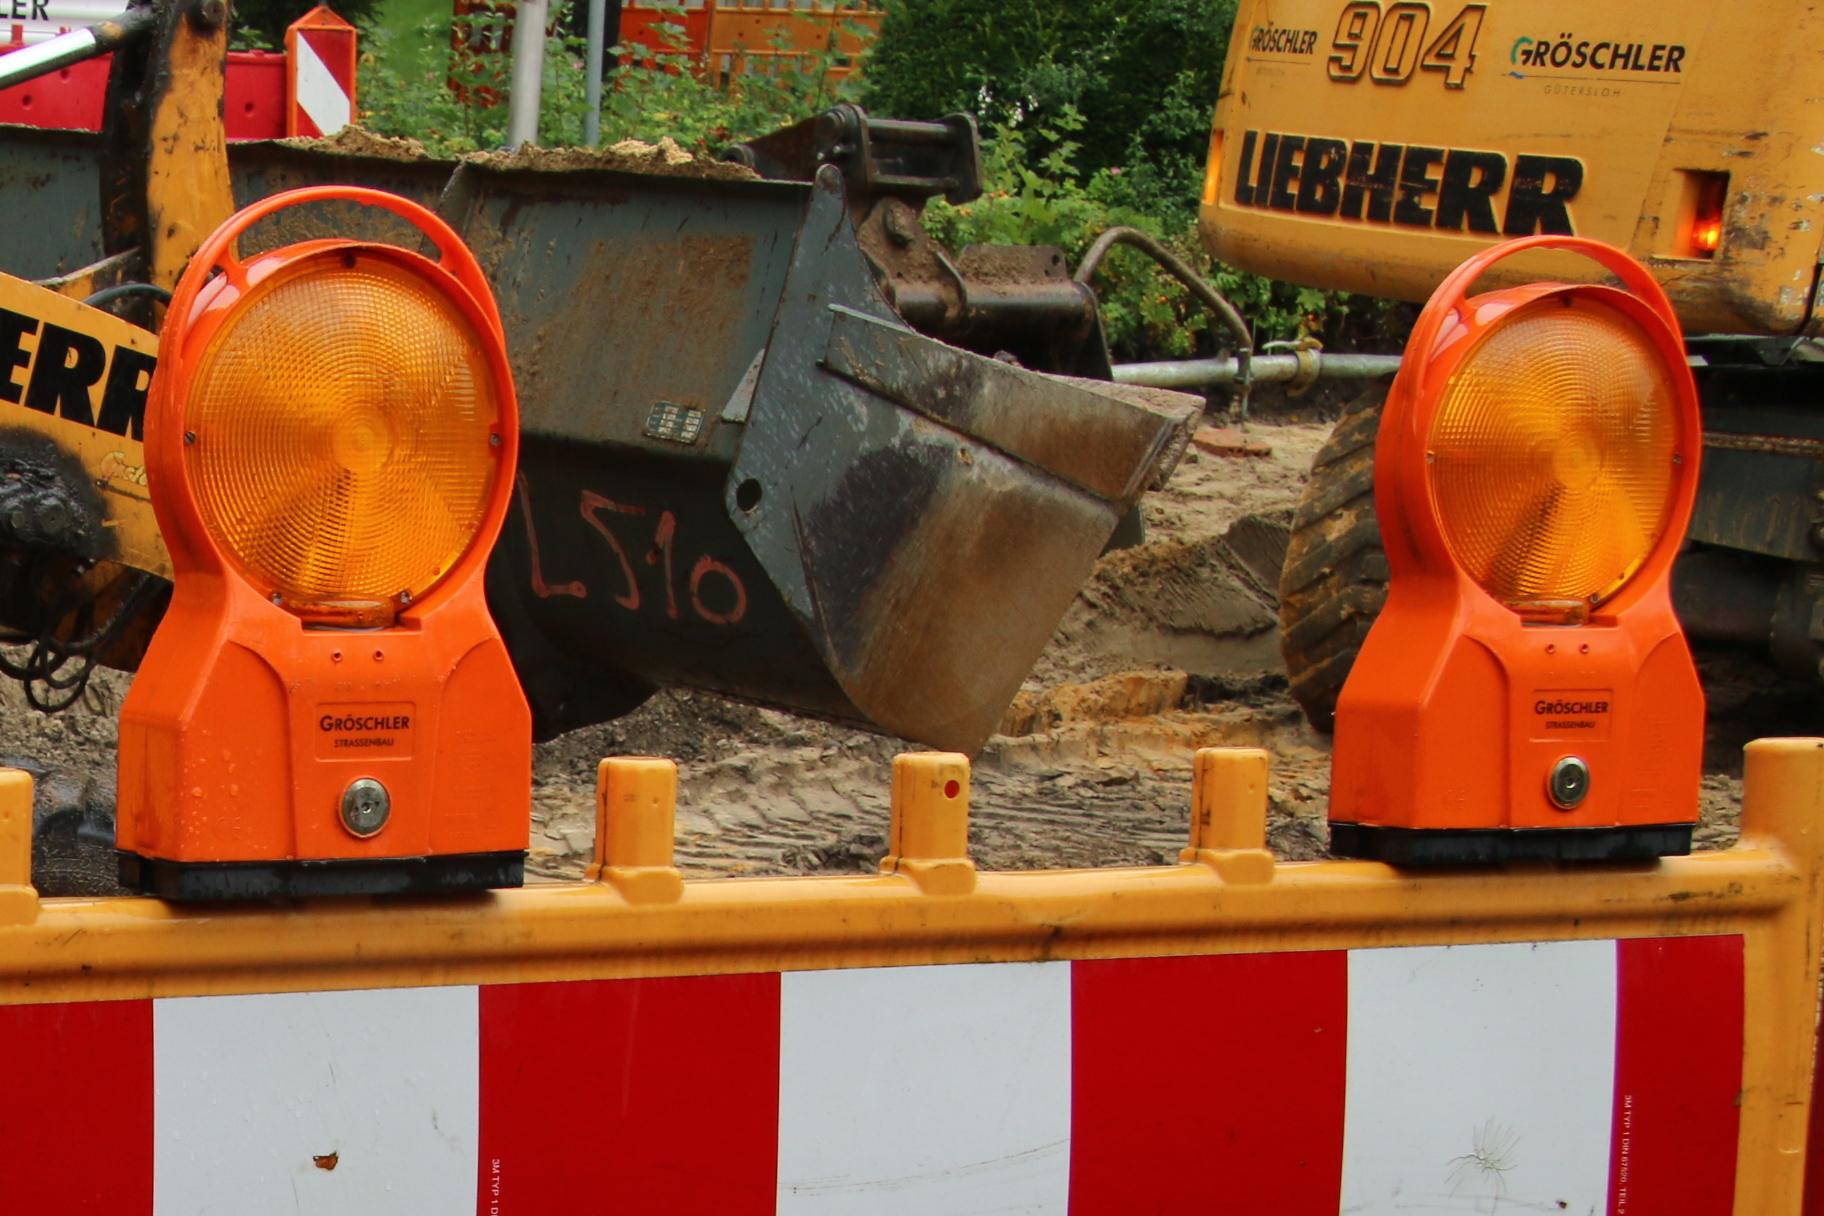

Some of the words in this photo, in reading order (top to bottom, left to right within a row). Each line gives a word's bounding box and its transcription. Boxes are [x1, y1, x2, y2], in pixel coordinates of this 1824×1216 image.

[1327, 1, 1487, 90] 904
[1511, 32, 1686, 73] GRÖSCHLER
[1235, 129, 1585, 236] LIEBHERR
[1534, 699, 1608, 715] GRÖSCHLER
[319, 714, 410, 732] GRÖSCHLER
[334, 738, 394, 748] STRASSENBAU
[1623, 1110, 1631, 1128] TYP
[1622, 1138, 1630, 1155] DIN
[491, 1158, 500, 1174] 3M
[491, 1176, 500, 1196] TYP
[1618, 1187, 1627, 1207] TEIL
